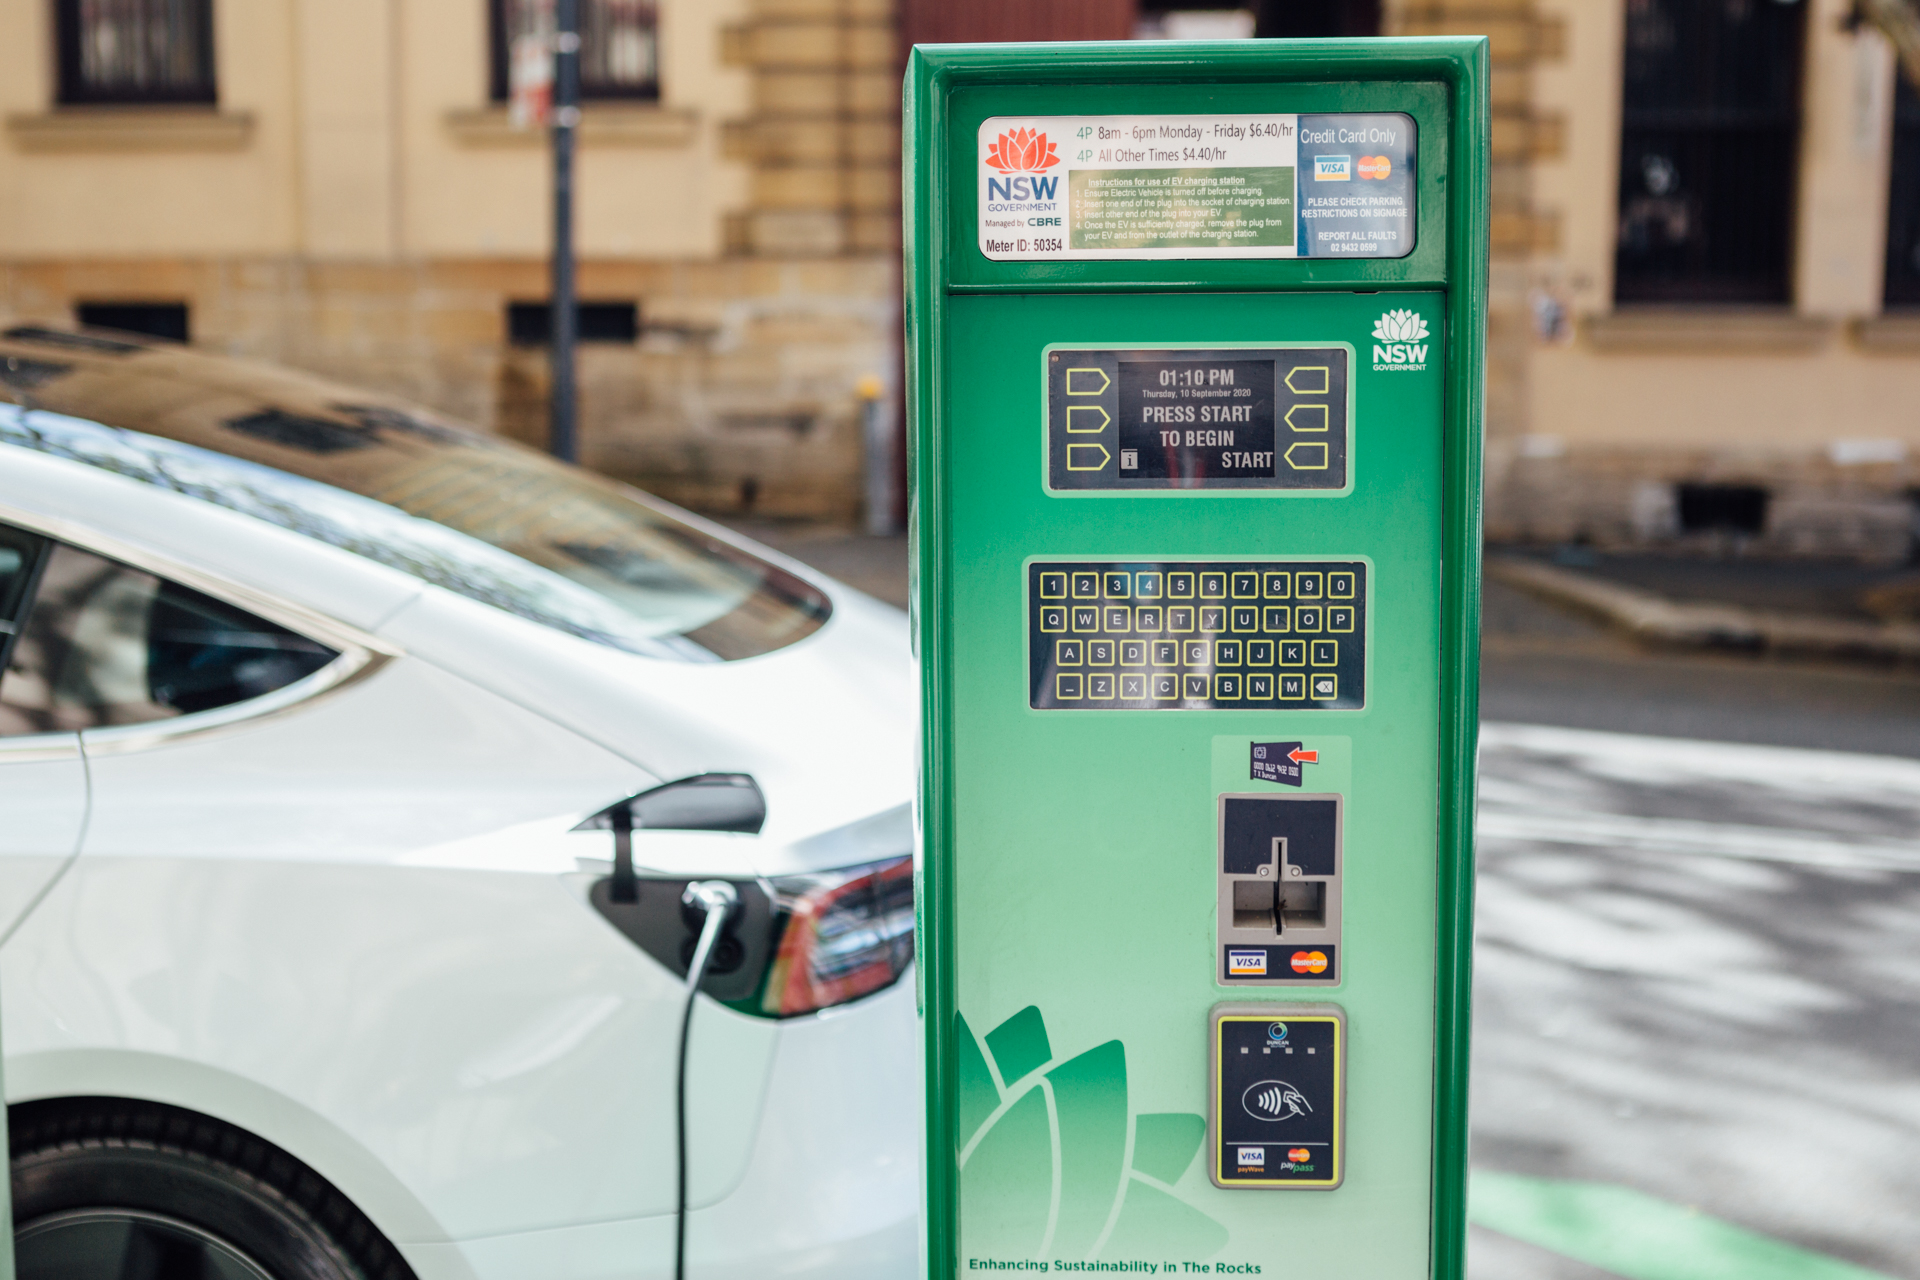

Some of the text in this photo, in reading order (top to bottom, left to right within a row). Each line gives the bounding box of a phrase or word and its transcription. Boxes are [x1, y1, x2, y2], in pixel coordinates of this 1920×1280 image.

[1076, 122, 1293, 142] 4P 8am 6pm Monday Friday $6.40/hr
[1300, 128, 1396, 146] Credit Card Only
[1076, 147, 1226, 162] 4P All Other Times $4.40/hr
[1320, 163, 1345, 173] VISA
[1358, 164, 1390, 172] MasterCard
[1088, 178, 1132, 187] Instructions
[1134, 178, 1145, 186] for
[1172, 177, 1183, 185] EV
[1184, 176, 1217, 186] charging
[1219, 176, 1245, 185] station
[988, 176, 1059, 201] NSW
[1084, 186, 1263, 197] Ensure Electric Vehicle is turned off before charging.
[1084, 200, 1104, 208] Insert
[1120, 199, 1134, 207] end
[1135, 199, 1143, 207] of
[1143, 199, 1155, 207] the
[1157, 198, 1172, 208] plug
[1173, 198, 1186, 206] into
[1188, 198, 1200, 206] the
[1201, 198, 1224, 206] socket
[1234, 197, 1265, 207] charging
[1266, 197, 1291, 205] station.
[1308, 196, 1403, 206] PLEASE CHECK PARKING
[988, 203, 1057, 212] GOVERNMENT
[1301, 208, 1408, 218] RESTRICTIONS ON SIGNAGE
[1106, 210, 1123, 218] other
[1125, 210, 1139, 218] end
[1161, 209, 1176, 219] plug
[1178, 209, 1191, 217] into
[1193, 210, 1208, 218] your
[985, 217, 1062, 228] Managed by CBRE
[1084, 221, 1103, 229] Once
[1105, 221, 1116, 229] the
[1138, 220, 1174, 229] sufficiently
[1249, 218, 1264, 228] plug
[1265, 218, 1281, 226] from
[1084, 232, 1100, 241] your
[1101, 231, 1112, 239] EV
[1114, 231, 1127, 239] and
[1128, 231, 1145, 239] from
[1159, 230, 1179, 238] outlet
[1180, 230, 1188, 238] of
[1189, 230, 1200, 238] the
[1201, 230, 1232, 239] charging
[1233, 229, 1258, 237] station.
[1318, 231, 1397, 240] REPORT ALL FAULTS
[986, 238, 1062, 252] Meter ID: 50354
[1330, 243, 1377, 252] 02 9432 0599
[1373, 344, 1429, 363] NSW
[1160, 369, 1234, 386] 01:10 PM
[1142, 388, 1251, 399] Thursday, 10 September 2020
[1143, 405, 1253, 423] PRESS START
[1160, 430, 1234, 447] TO BEGIN
[1222, 451, 1274, 468] START
[1050, 580, 1345, 591] 1 2 3 4 5 6 7 8 9 0
[1048, 614, 1059, 625] Q
[1079, 614, 1092, 625] W
[1113, 614, 1121, 625] E
[1144, 614, 1154, 625] R
[1176, 614, 1185, 625] T
[1208, 614, 1217, 625] Y
[1240, 614, 1249, 625] U
[1303, 614, 1314, 625] O
[1336, 614, 1345, 625] P
[1064, 648, 1328, 659] A S D F G H J K L
[1097, 681, 1297, 692] Z X C V B N M
[1236, 958, 1261, 967] VISA
[1240, 1152, 1263, 1160] VISA
[969, 1258, 1262, 1274] Enhancing Sustainability in The Rocks
